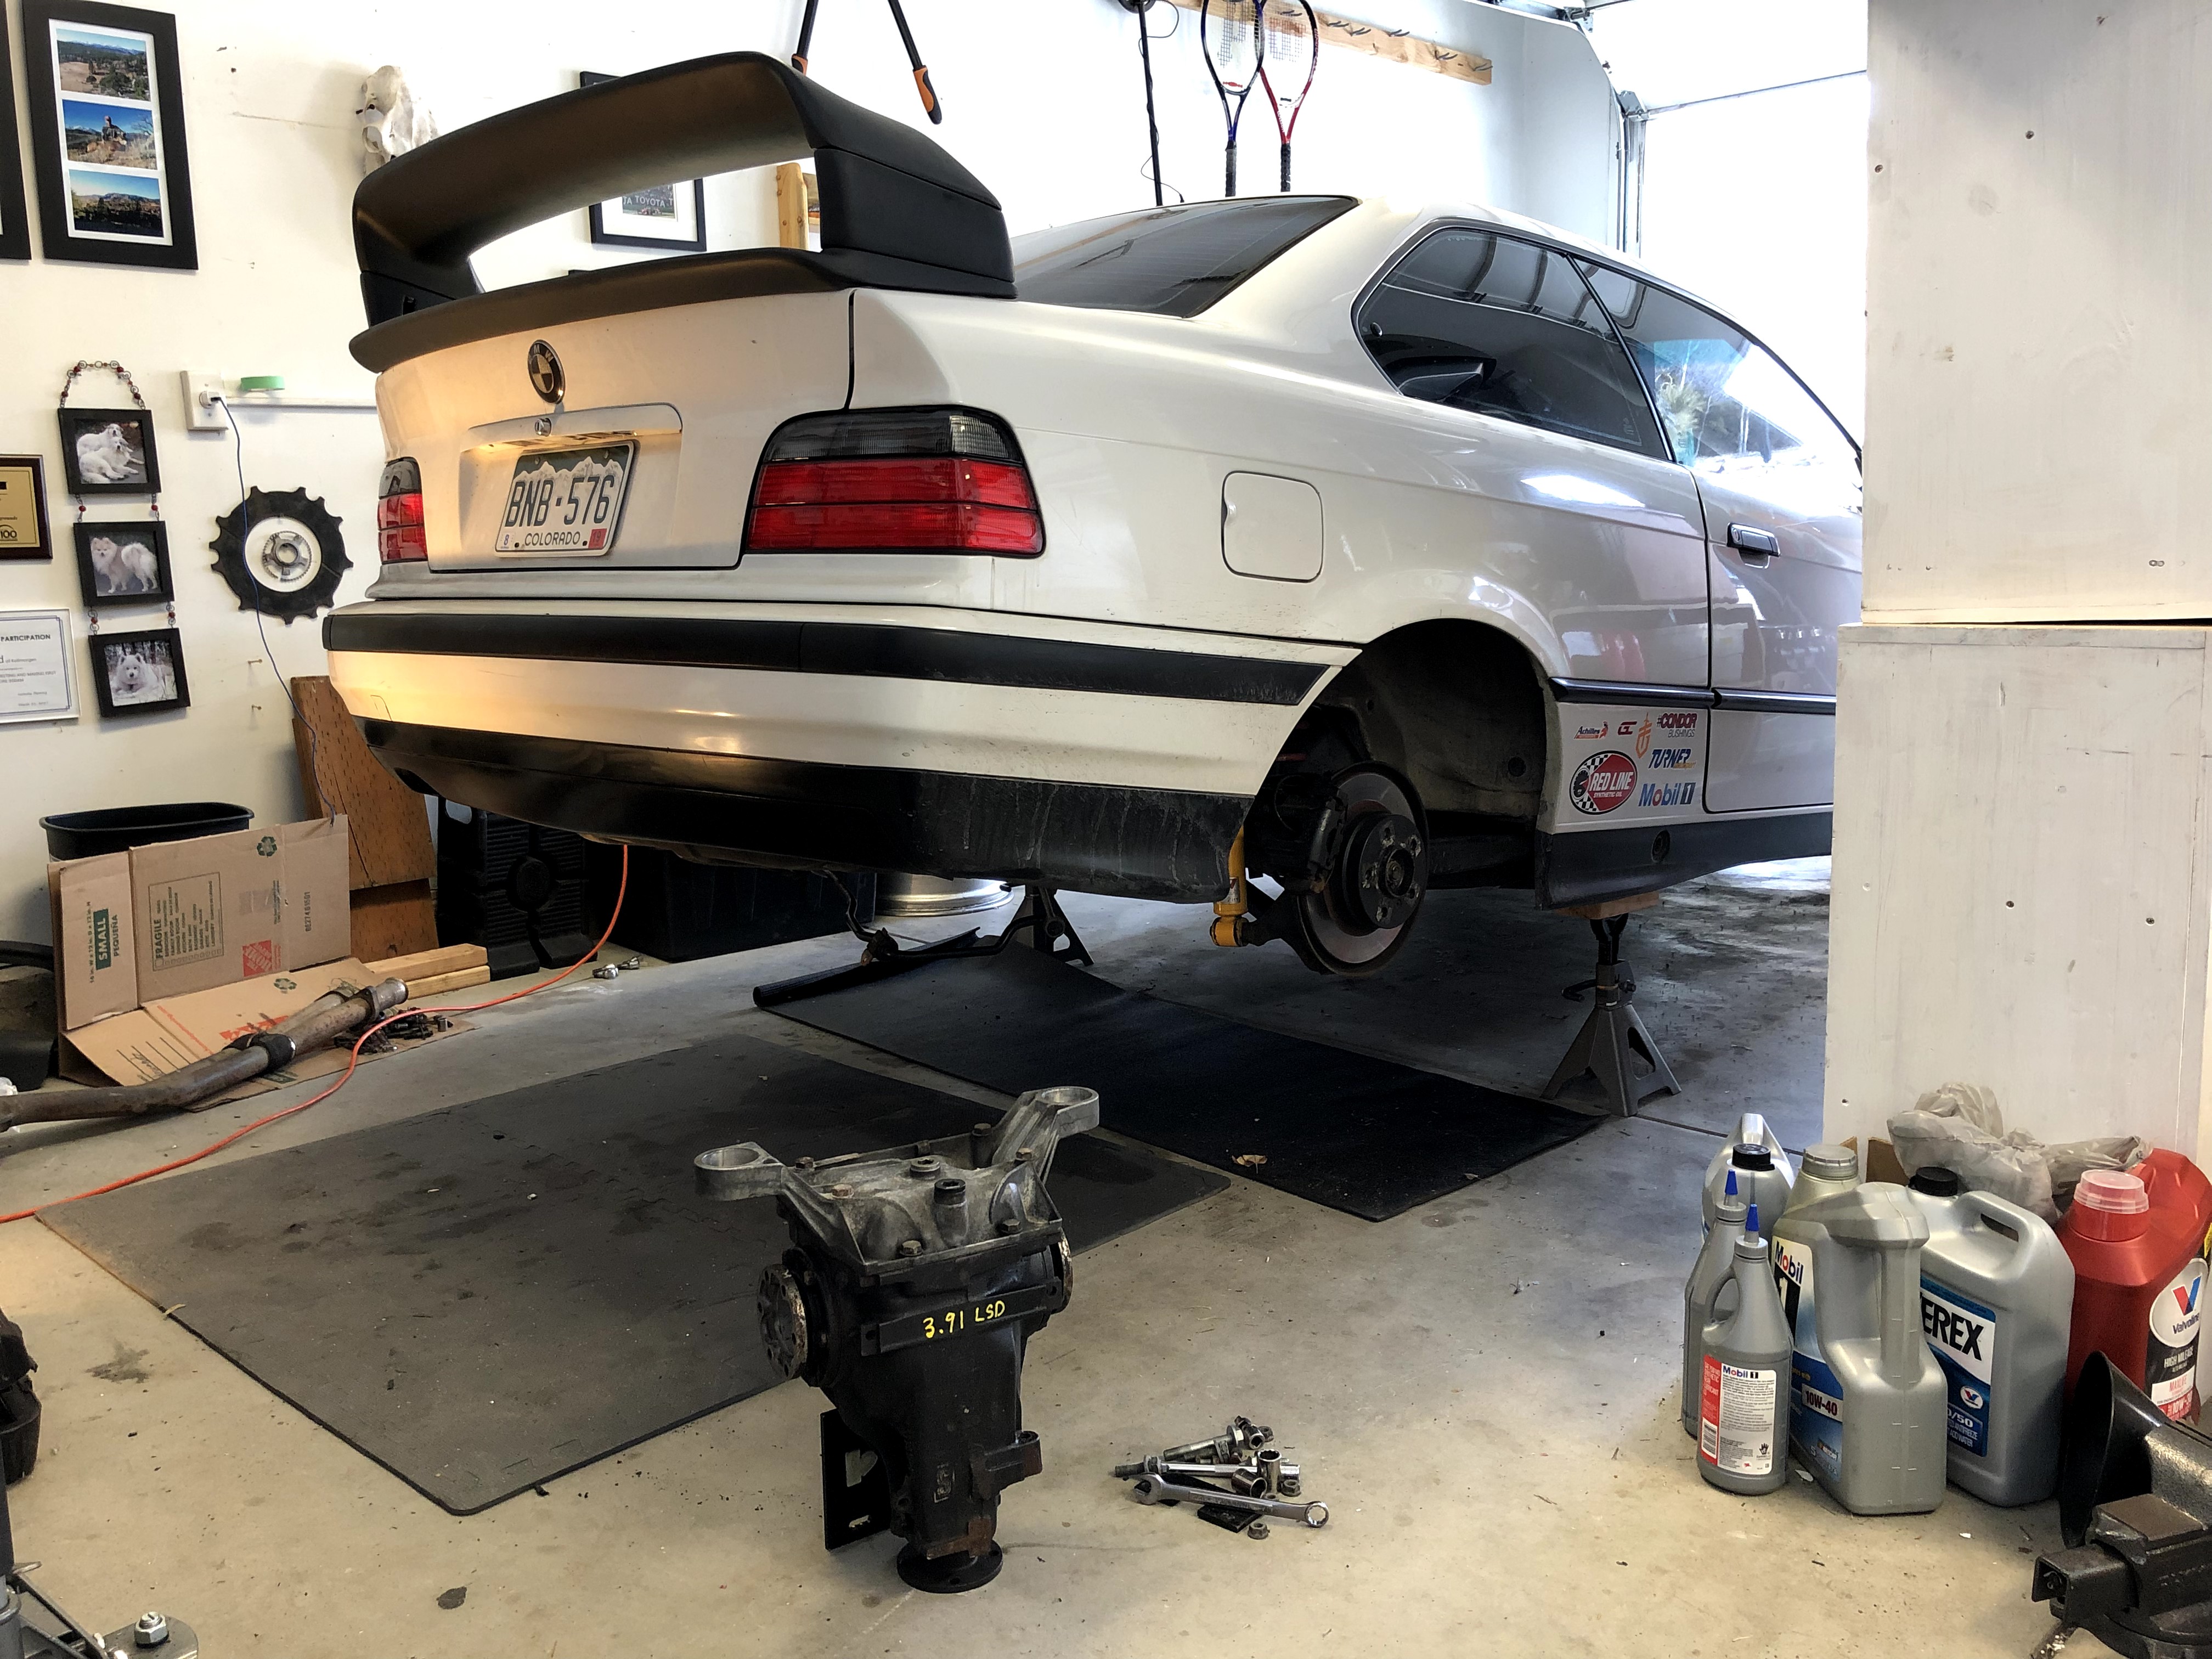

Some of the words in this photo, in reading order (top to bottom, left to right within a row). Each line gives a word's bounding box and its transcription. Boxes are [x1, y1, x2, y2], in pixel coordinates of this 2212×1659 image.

[635, 195, 665, 208] TOYOTA
[525, 532, 580, 546] COLORADO
[1575, 726, 1600, 737] Achilles
[1668, 729, 1695, 738] BUSHINGS
[1648, 749, 1691, 769] TURNER
[1589, 772, 1611, 791] RED
[1610, 772, 1634, 790] LINE
[1638, 783, 1681, 806] Mobil
[97, 918, 107, 960] SMALL
[111, 915, 119, 956] PEQUEÑA
[154, 919, 162, 958] FRAGILE
[1775, 1240, 1804, 1284] Mobil
[922, 1310, 964, 1339] 3.91
[974, 1300, 1005, 1322] LSD
[1920, 1292, 1984, 1361] EREX
[1723, 1365, 1748, 1378] Mobil
[2164, 1355, 2177, 1368] HIGH
[1805, 1390, 1838, 1416] 10W-40
